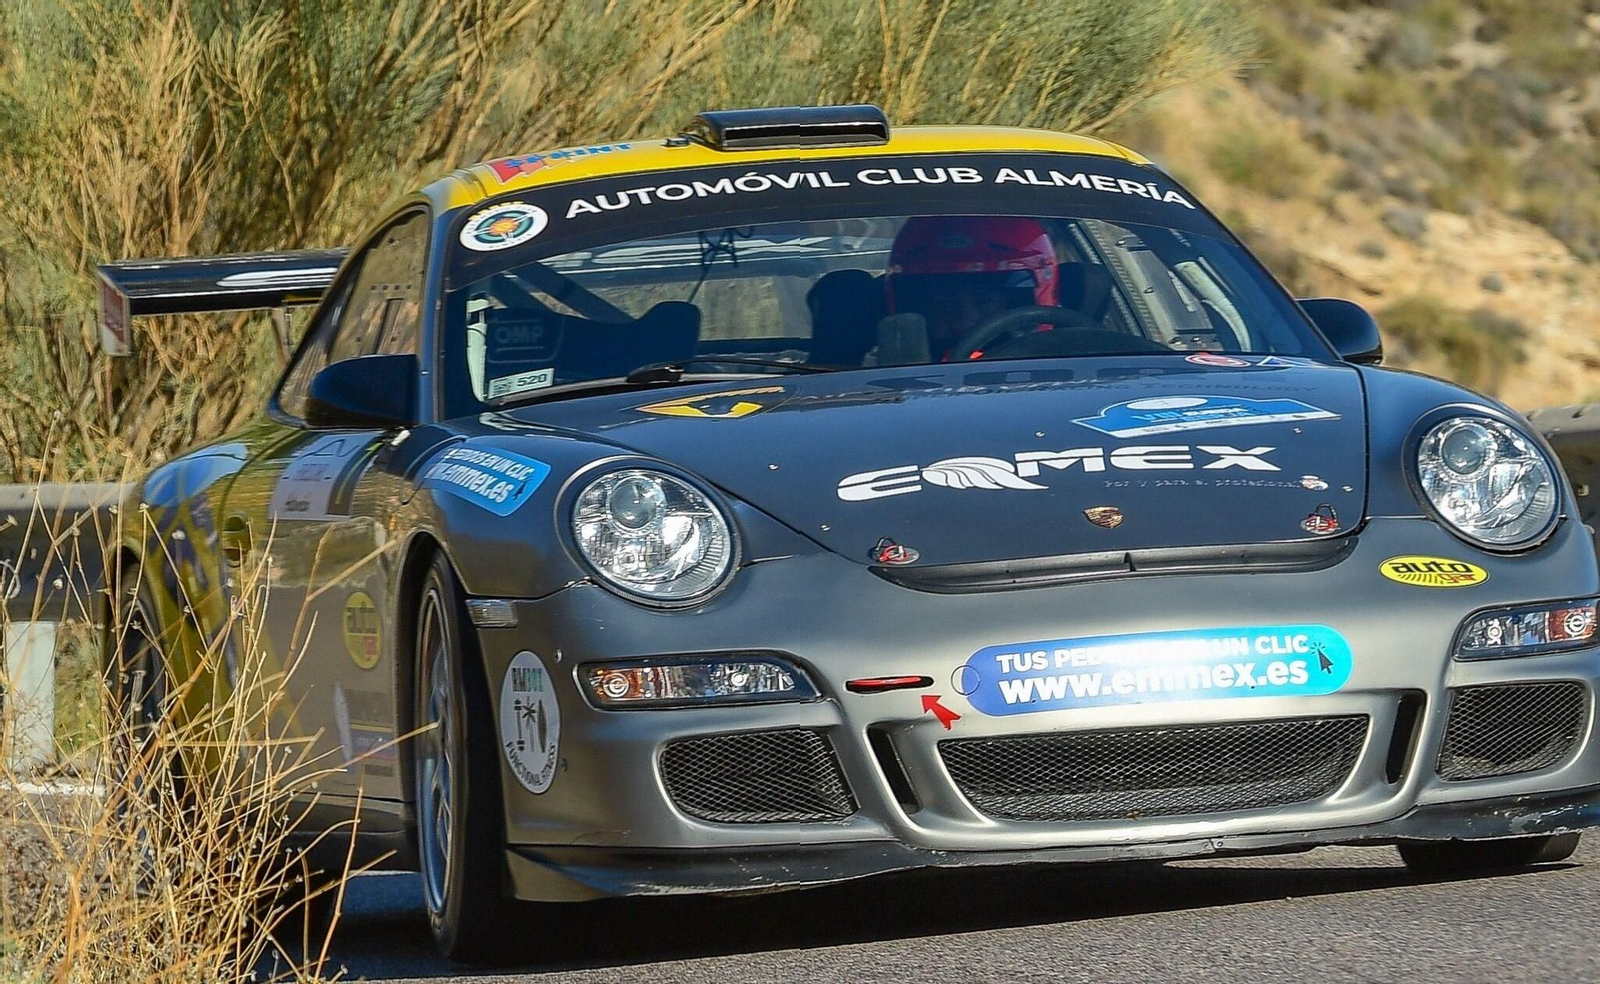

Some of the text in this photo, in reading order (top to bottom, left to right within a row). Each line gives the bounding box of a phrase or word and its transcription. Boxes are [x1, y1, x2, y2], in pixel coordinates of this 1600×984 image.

[565, 167, 1196, 219] AUTOMÓVIL CLUB ALMERÍA
[517, 373, 547, 387] 520
[1388, 560, 1474, 574] auto
[996, 650, 1049, 674] TUS
[1254, 634, 1309, 655] CLIC
[998, 659, 1309, 705] www.emmex.es
